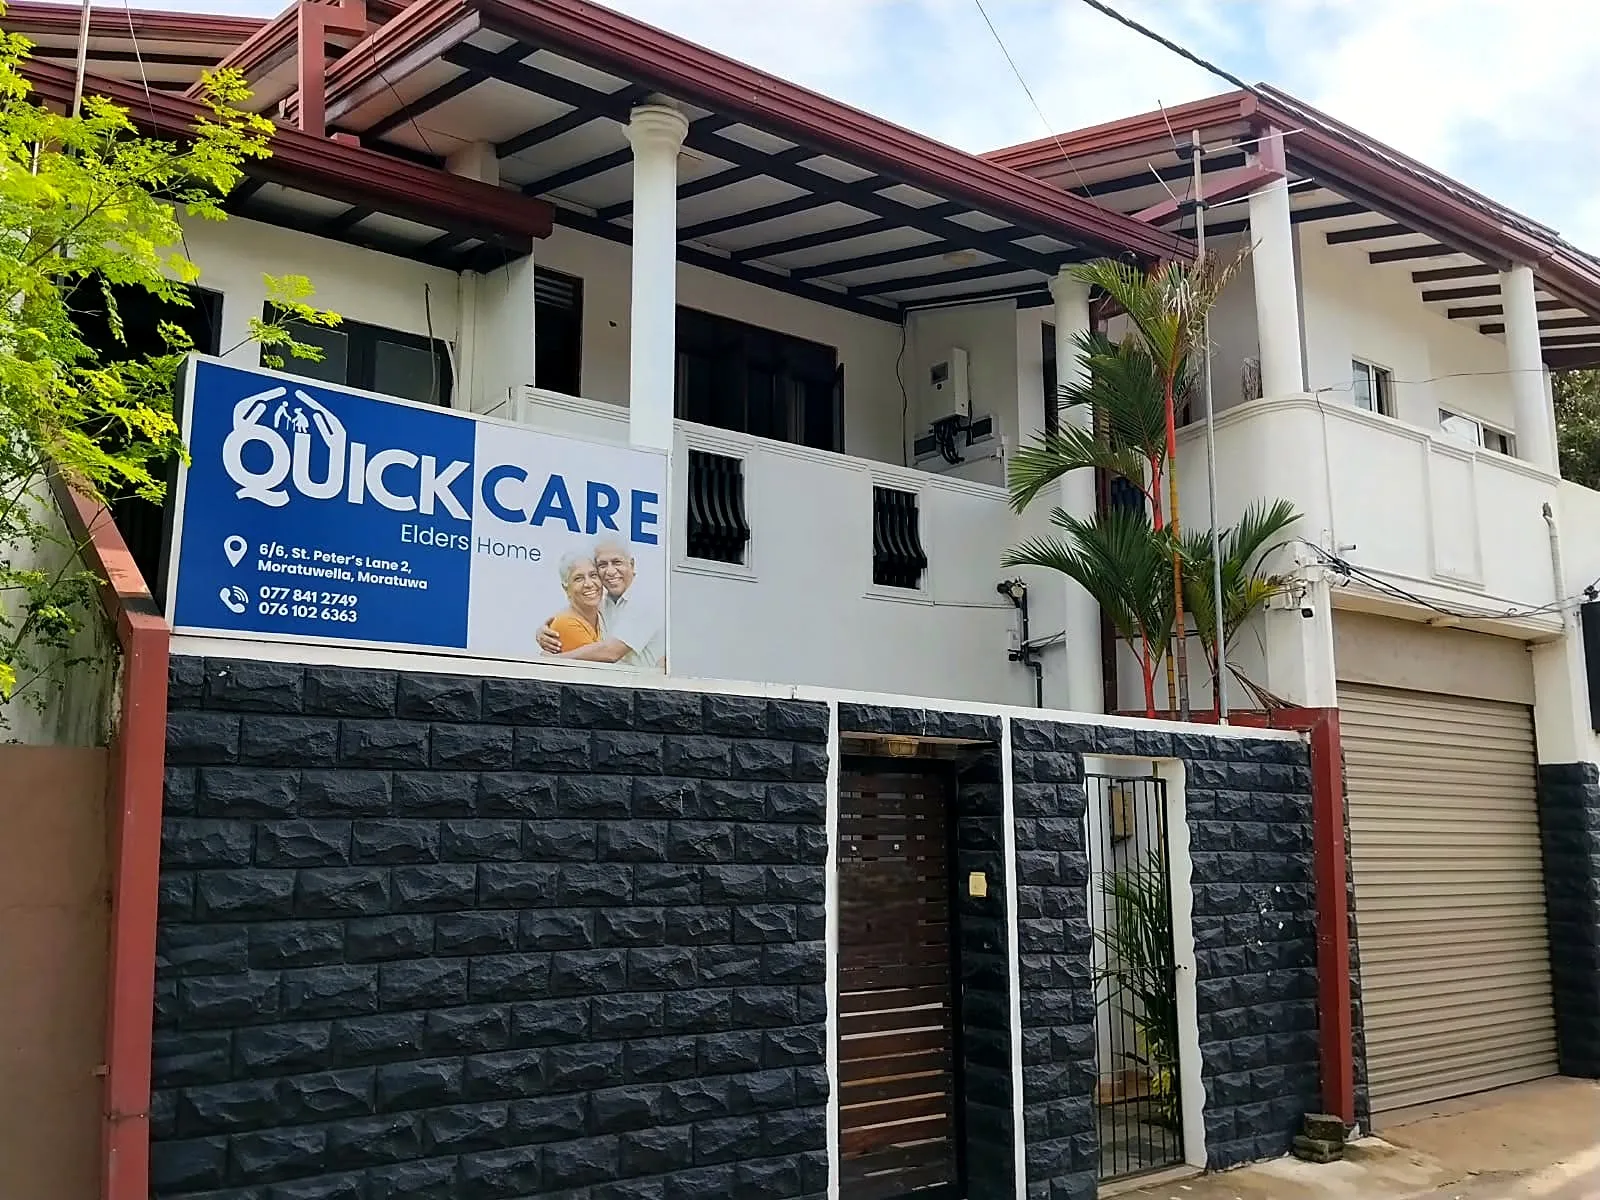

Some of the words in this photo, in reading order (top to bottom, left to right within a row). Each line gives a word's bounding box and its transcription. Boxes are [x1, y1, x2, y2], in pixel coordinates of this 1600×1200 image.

[481, 464, 659, 545] CARE
[259, 541, 289, 559] 6/6,
[291, 547, 311, 560] St.
[313, 550, 363, 567] Peter's
[365, 556, 399, 571] Lane
[400, 560, 412, 574] 2,
[401, 523, 470, 551] Elders
[477, 536, 541, 562] Home
[257, 559, 355, 583] Moratuwella,
[357, 571, 428, 590] Moratuwa
[258, 602, 289, 616] 076
[292, 604, 318, 619] 102
[321, 607, 358, 623] 6363
[259, 586, 291, 600] 077
[292, 589, 317, 603] 841
[320, 592, 358, 607] 2749
